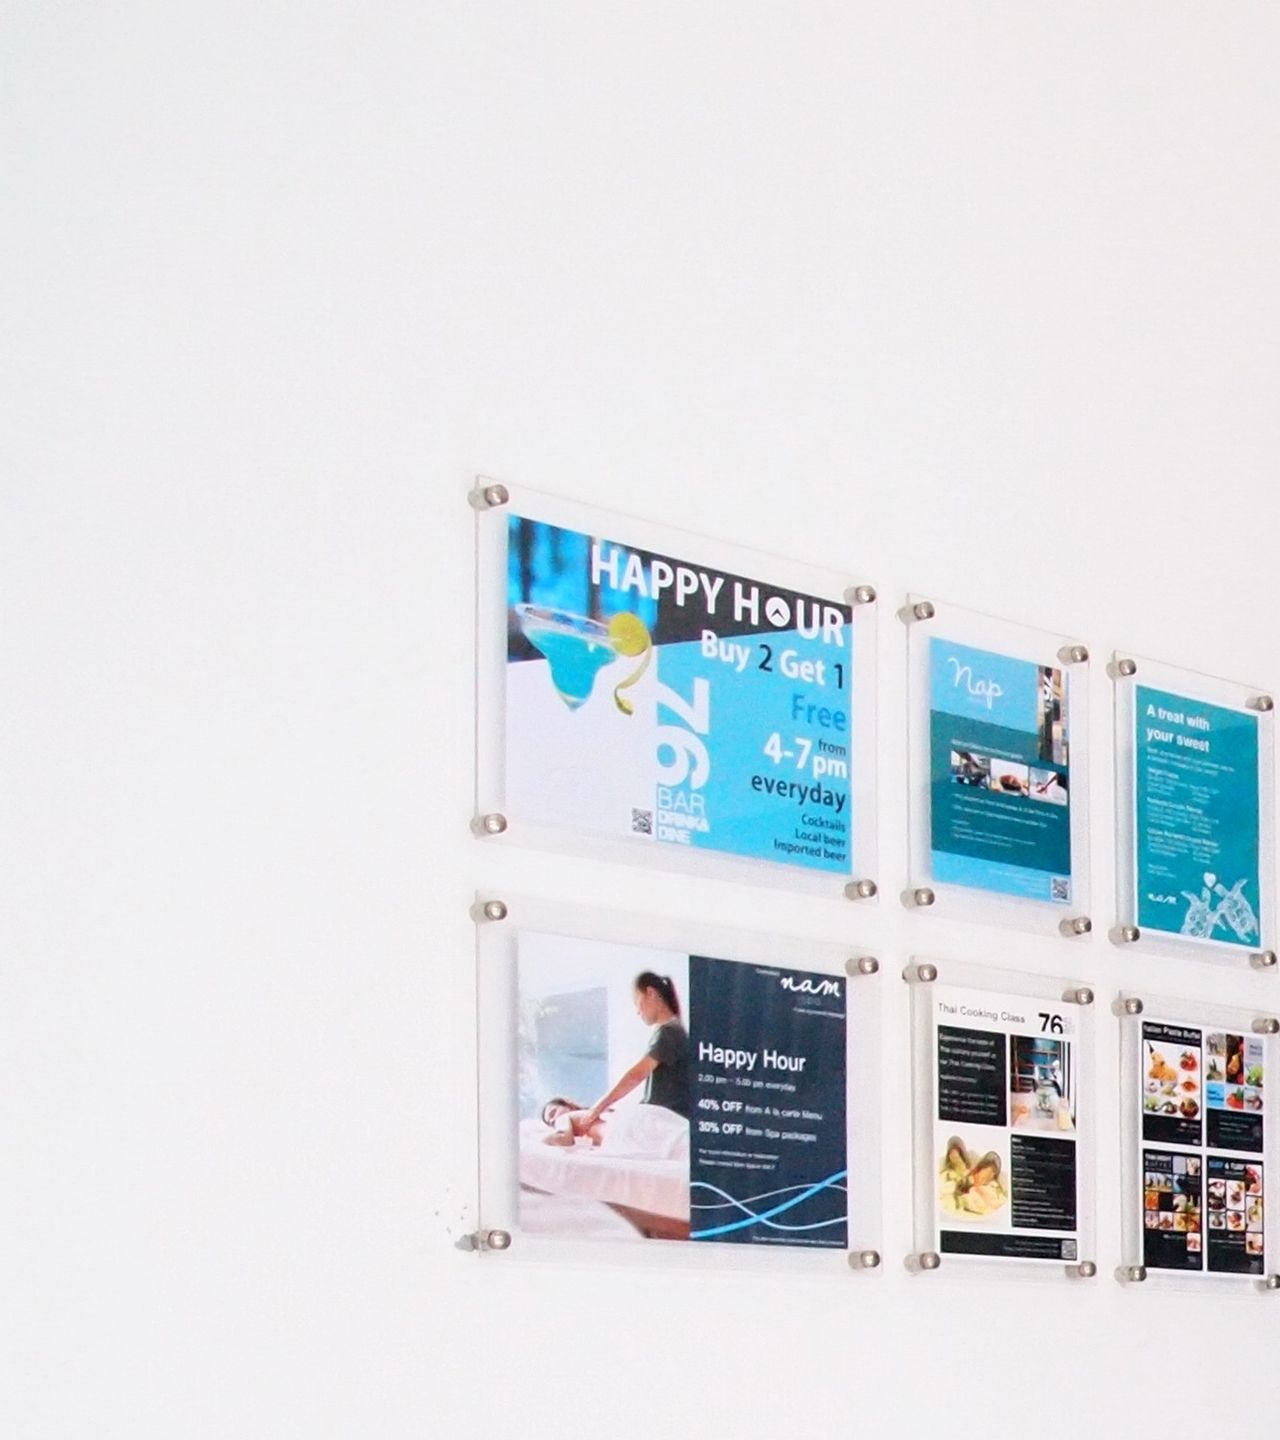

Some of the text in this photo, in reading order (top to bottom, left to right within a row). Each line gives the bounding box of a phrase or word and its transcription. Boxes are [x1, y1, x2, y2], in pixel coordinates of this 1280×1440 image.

[592, 545, 844, 647] HAPPY HOUR
[702, 629, 844, 689] Buy 2 Get 1
[948, 657, 1004, 709] Nap
[791, 694, 847, 732] Free
[1146, 704, 1210, 731] A treat with
[818, 738, 846, 756] from
[1146, 728, 1210, 752] your sweet
[658, 787, 705, 815] BAR
[752, 774, 846, 814] everyday
[801, 814, 846, 833] Cocktails
[774, 839, 846, 861] Imported beer
[795, 829, 846, 848] Local beer
[939, 1003, 1025, 1023] Thai Cooking Class
[699, 1042, 806, 1072] Happy Hour
[722, 1100, 743, 1112] OFF
[722, 1122, 743, 1134] OFF
